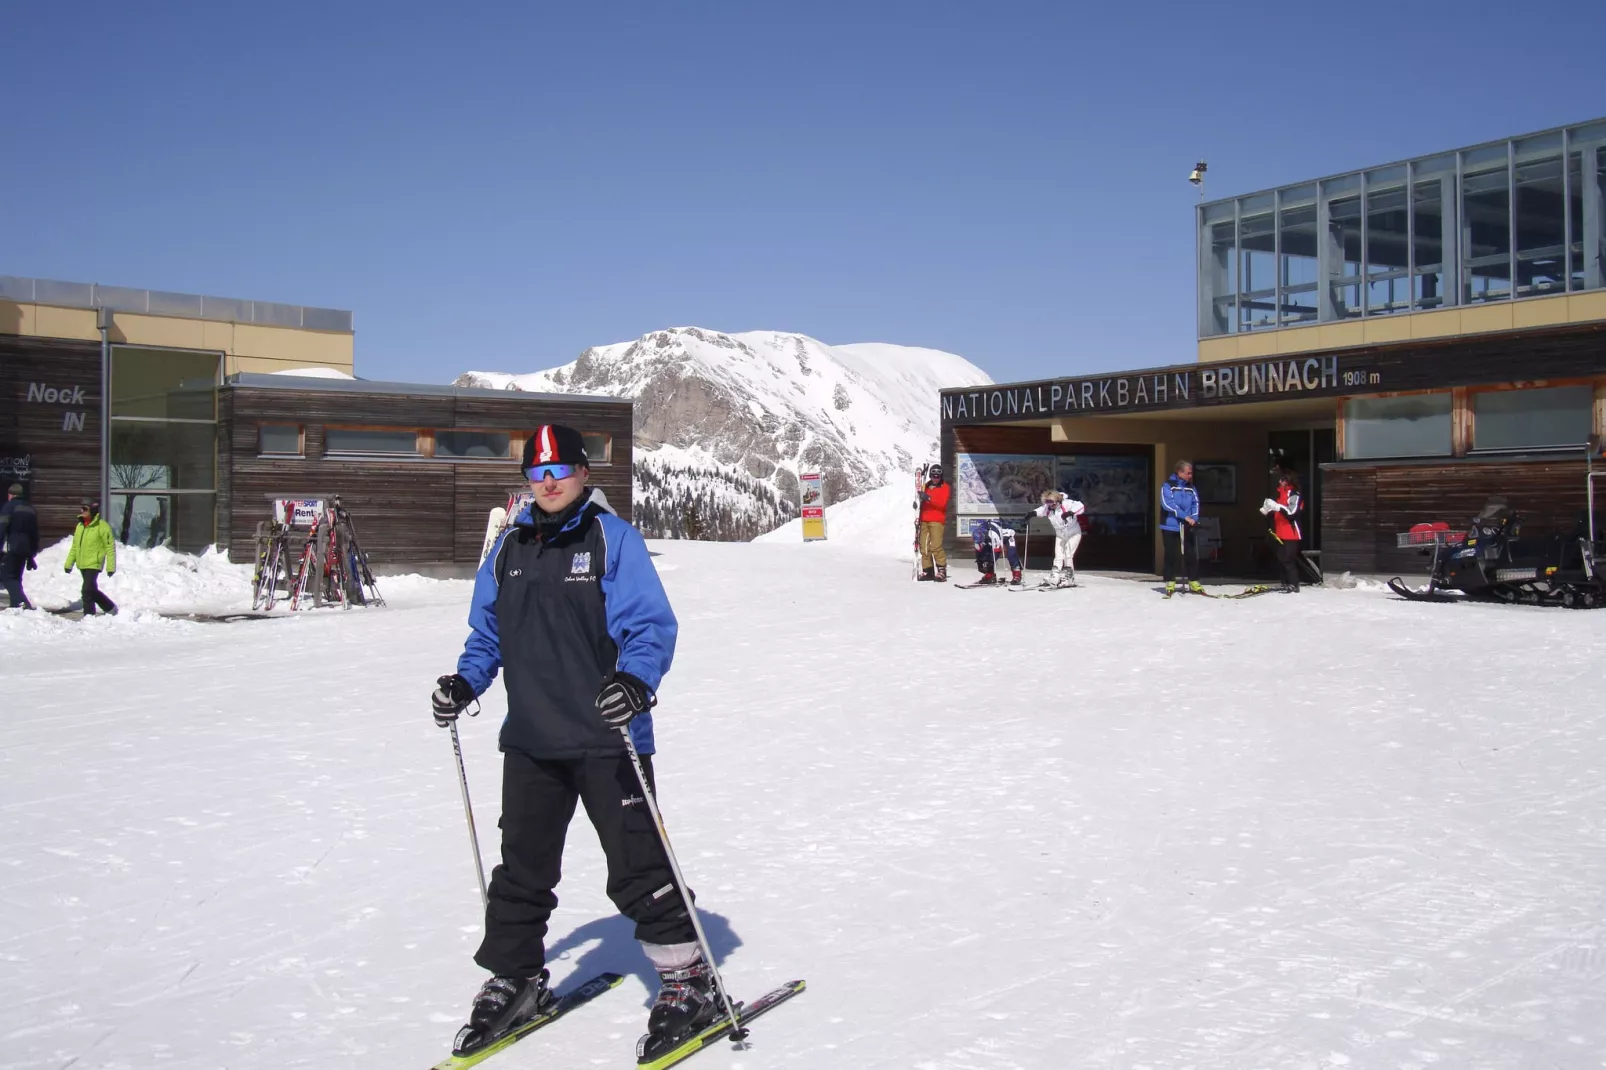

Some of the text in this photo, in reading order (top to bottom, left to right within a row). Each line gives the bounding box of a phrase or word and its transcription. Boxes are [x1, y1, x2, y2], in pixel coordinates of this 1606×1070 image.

[27, 382, 85, 404] Nock
[943, 372, 1189, 420] NATIONALPARKBAHN
[1202, 356, 1338, 399] BRUNNACH
[1369, 371, 1380, 384] m
[63, 411, 86, 432] IN
